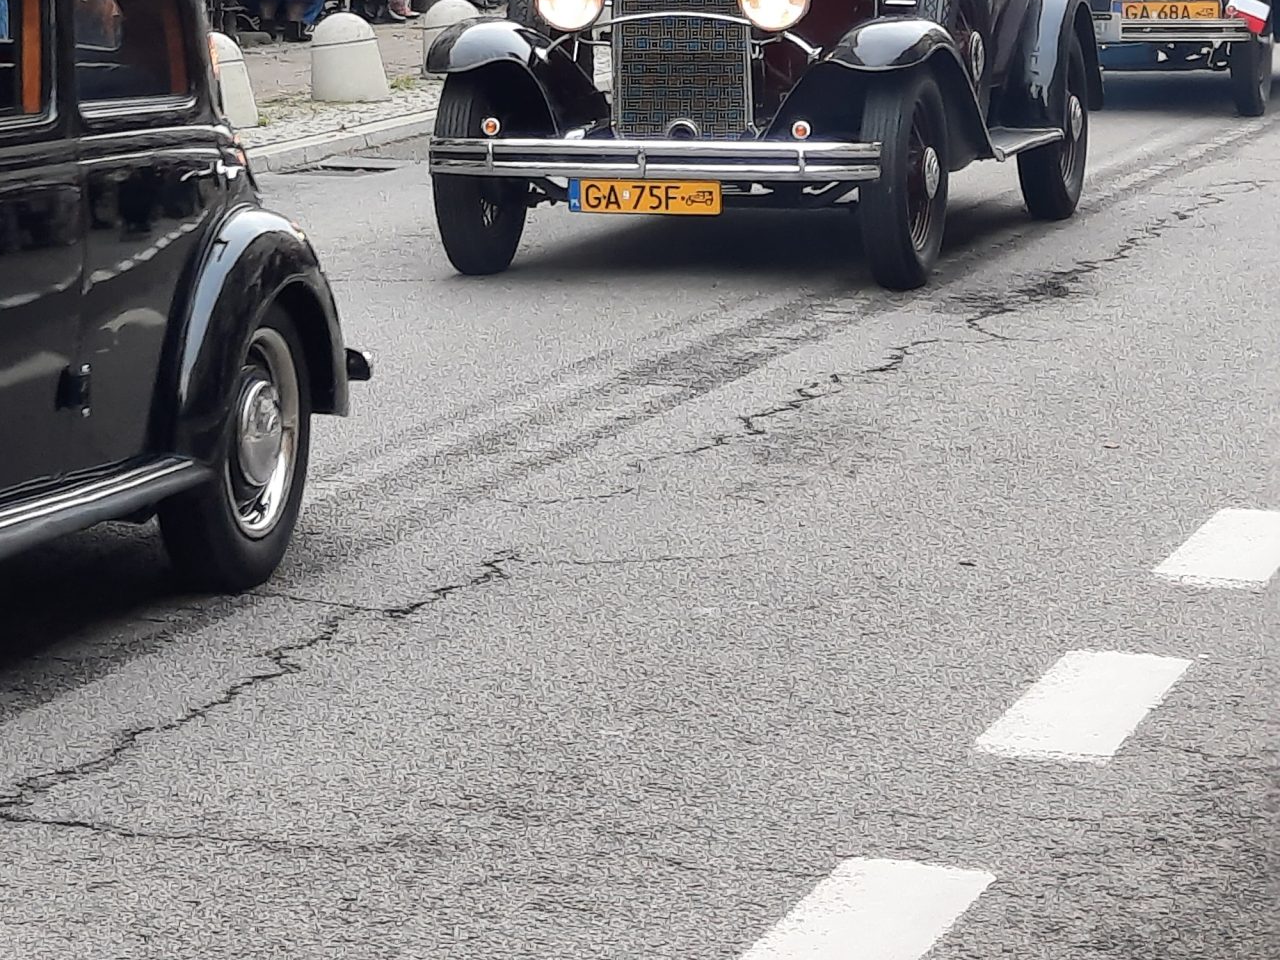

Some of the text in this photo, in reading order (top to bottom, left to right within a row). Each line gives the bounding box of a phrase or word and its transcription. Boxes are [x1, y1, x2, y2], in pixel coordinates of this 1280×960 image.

[1125, 4, 1191, 20] GA 68A
[585, 183, 681, 210] GA 75F
